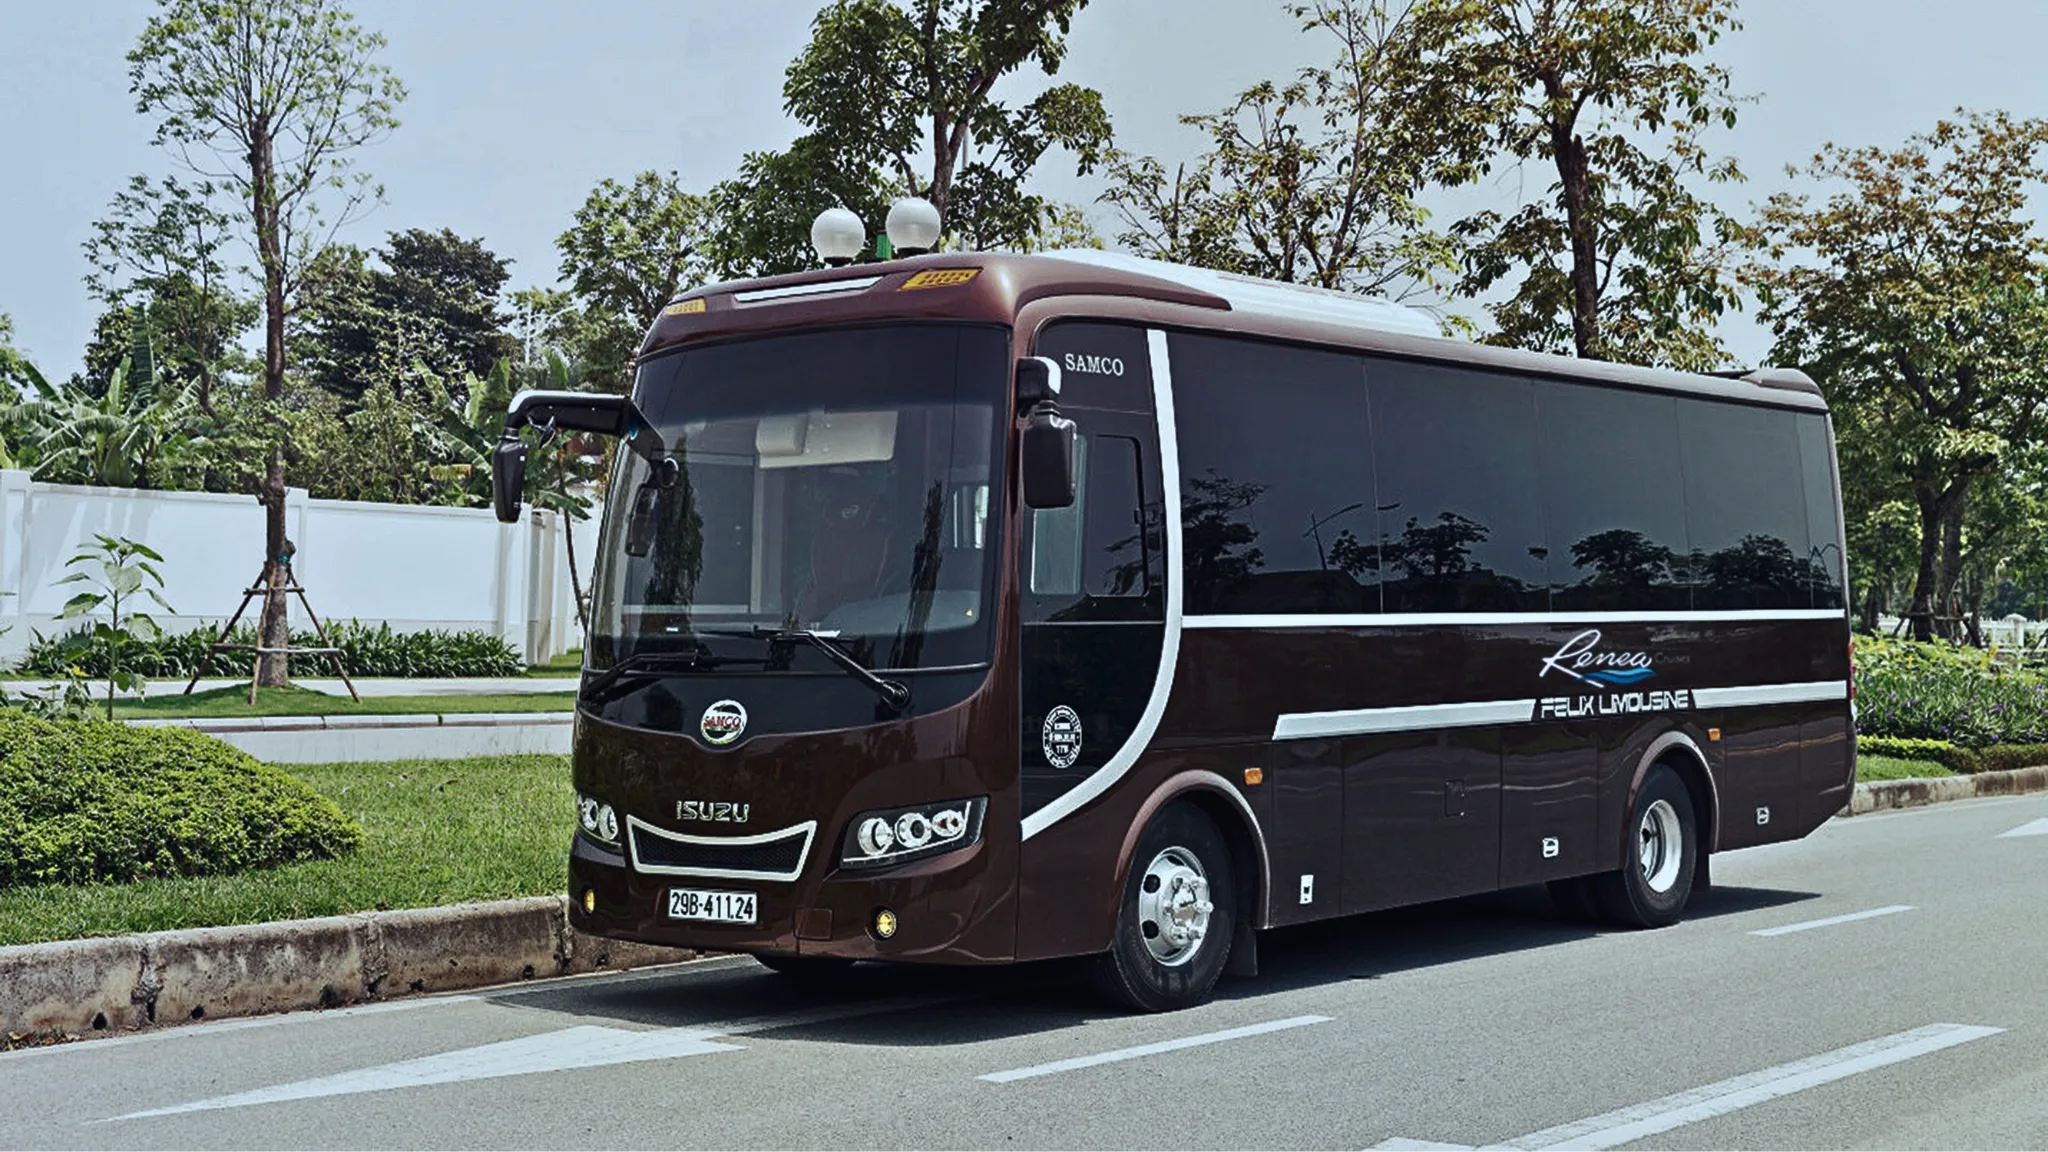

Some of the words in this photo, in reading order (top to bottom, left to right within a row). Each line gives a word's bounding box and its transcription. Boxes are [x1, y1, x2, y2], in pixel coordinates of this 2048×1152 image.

[1065, 353, 1124, 376] SAMCO
[1541, 696, 1594, 718] FELIX
[1600, 689, 1688, 714] LIMOUSINE
[703, 715, 742, 729] SAMCO
[676, 800, 749, 822] ISUZU
